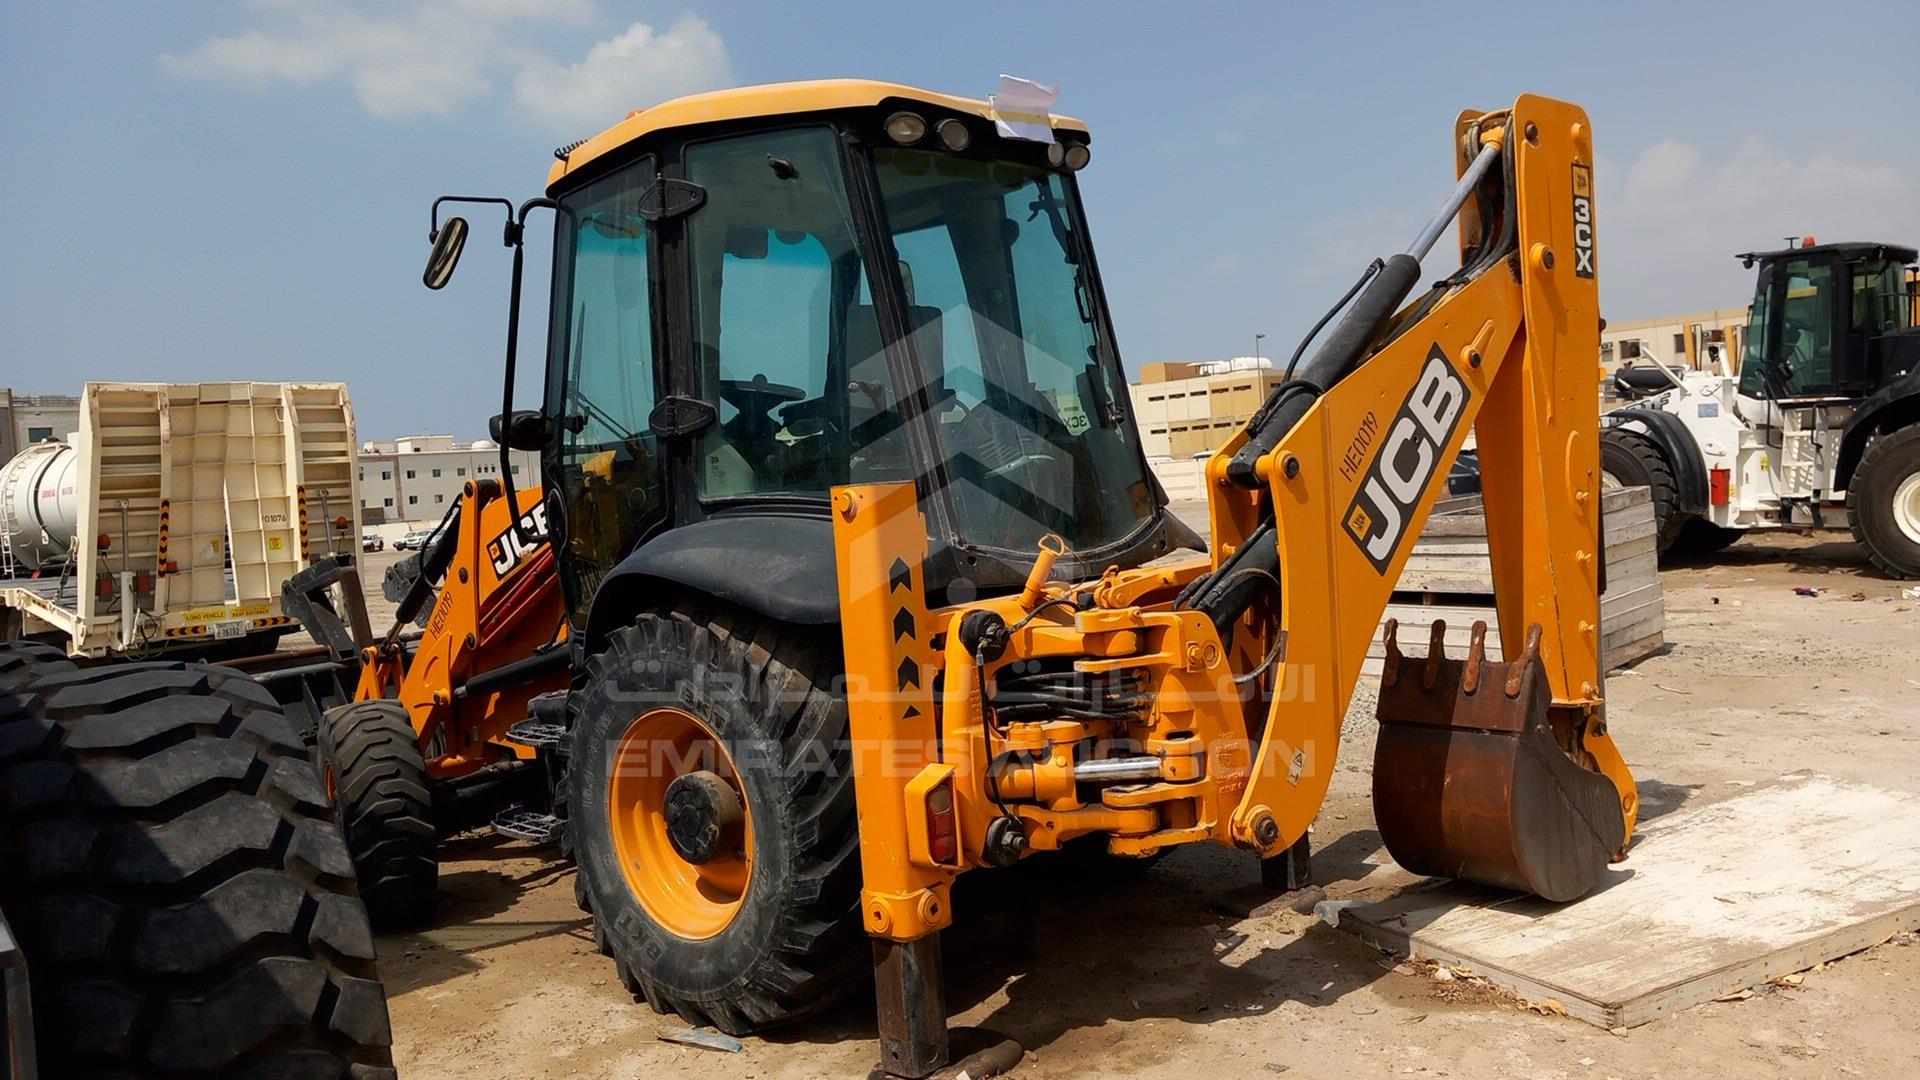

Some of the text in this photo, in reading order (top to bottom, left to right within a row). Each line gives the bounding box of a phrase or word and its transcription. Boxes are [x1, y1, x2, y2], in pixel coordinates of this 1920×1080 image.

[1575, 198, 1593, 273] 3CX
[1339, 411, 1378, 482] HE0019
[1365, 357, 1464, 561] JCB
[429, 591, 454, 640] HE0019
